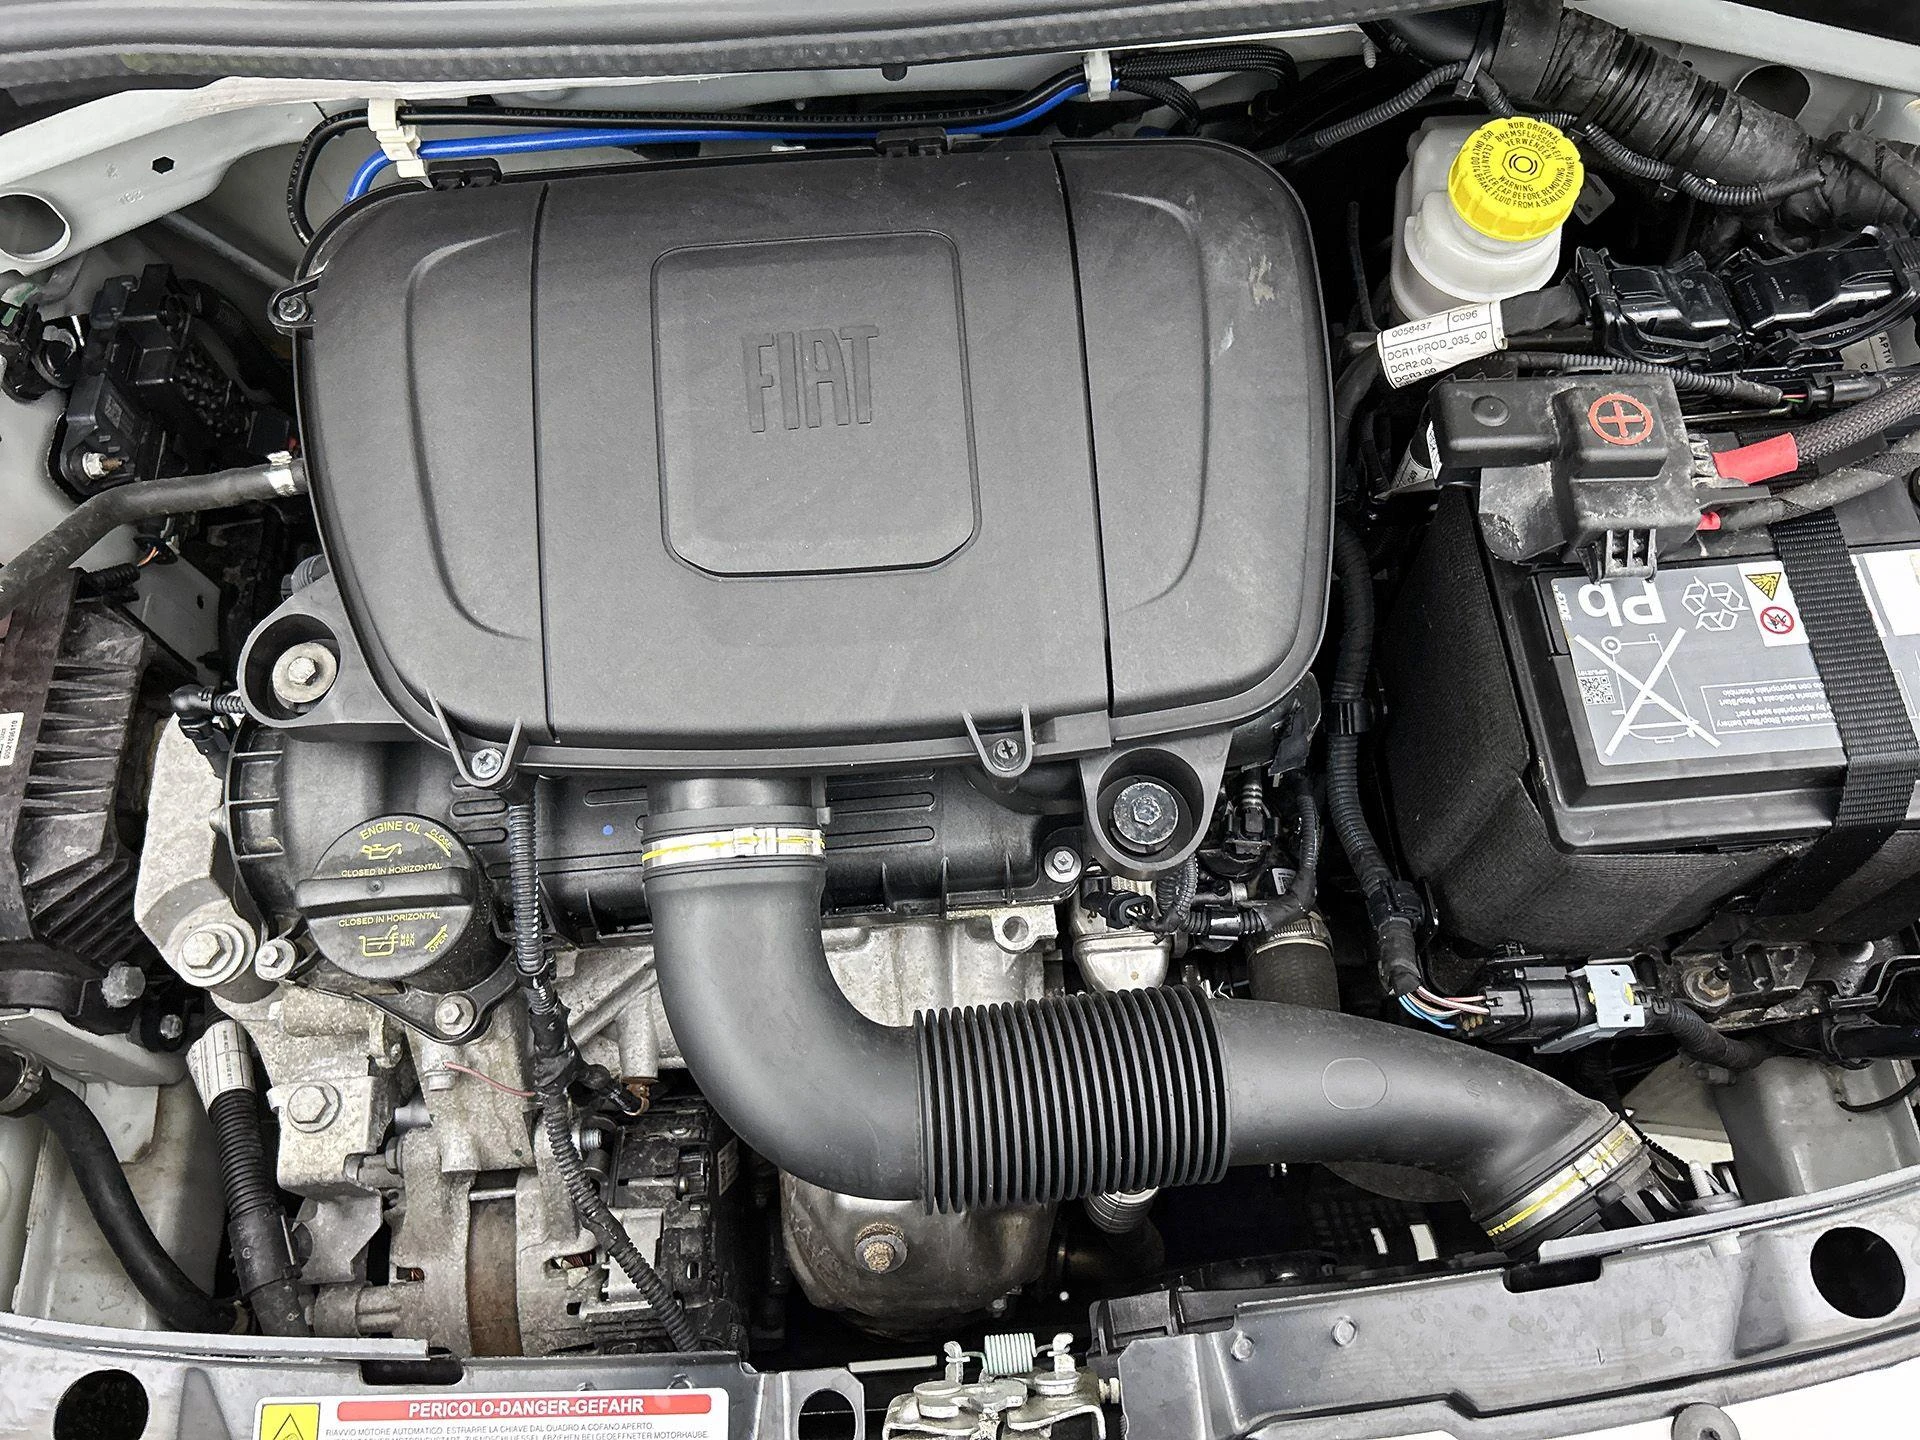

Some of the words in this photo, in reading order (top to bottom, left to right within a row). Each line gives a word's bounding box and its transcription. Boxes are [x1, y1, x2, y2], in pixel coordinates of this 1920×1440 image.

[1508, 121, 1525, 130] NUR
[1527, 122, 1561, 144] ORIGINAL
[1504, 138, 1553, 160] VERWENDEN
[1481, 143, 1495, 164] CLEAN
[1496, 184, 1512, 198] CAP
[1512, 190, 1543, 199] BEFORE
[1542, 167, 1566, 197] REMOVING
[1474, 172, 1495, 193] BRAKE
[1490, 190, 1512, 206] FLUID
[1512, 200, 1535, 209] FROM
[1542, 190, 1566, 207] SEALED
[1499, 175, 1534, 192] WARNING
[1391, 322, 1432, 338] 0058437
[1451, 309, 1478, 323] C096
[1879, 336, 1894, 365] APTIV
[1390, 357, 1433, 374] DCR2:00
[741, 325, 879, 433] FIAT
[1578, 579, 1667, 627] Pb
[360, 820, 403, 840] ENGINE
[405, 821, 420, 835] OIL
[430, 828, 453, 850] CLOSE
[341, 868, 376, 878] CLOSED
[378, 867, 387, 875] IN
[388, 862, 443, 874] HORIZONTAL
[338, 916, 374, 927] CLOSED
[387, 912, 441, 922] HORIZONTAL
[428, 931, 449, 953] OPEN
[408, 1398, 644, 1418] PERICOLO-DANGER-GEFAHR
[358, 1428, 391, 1436] MOTORE
[446, 1425, 487, 1434] ESTRARRE
[489, 1425, 499, 1433] LA
[500, 1425, 528, 1433] CHIAVE
[529, 1424, 545, 1432] DAL
[587, 1422, 621, 1431] COFANO
